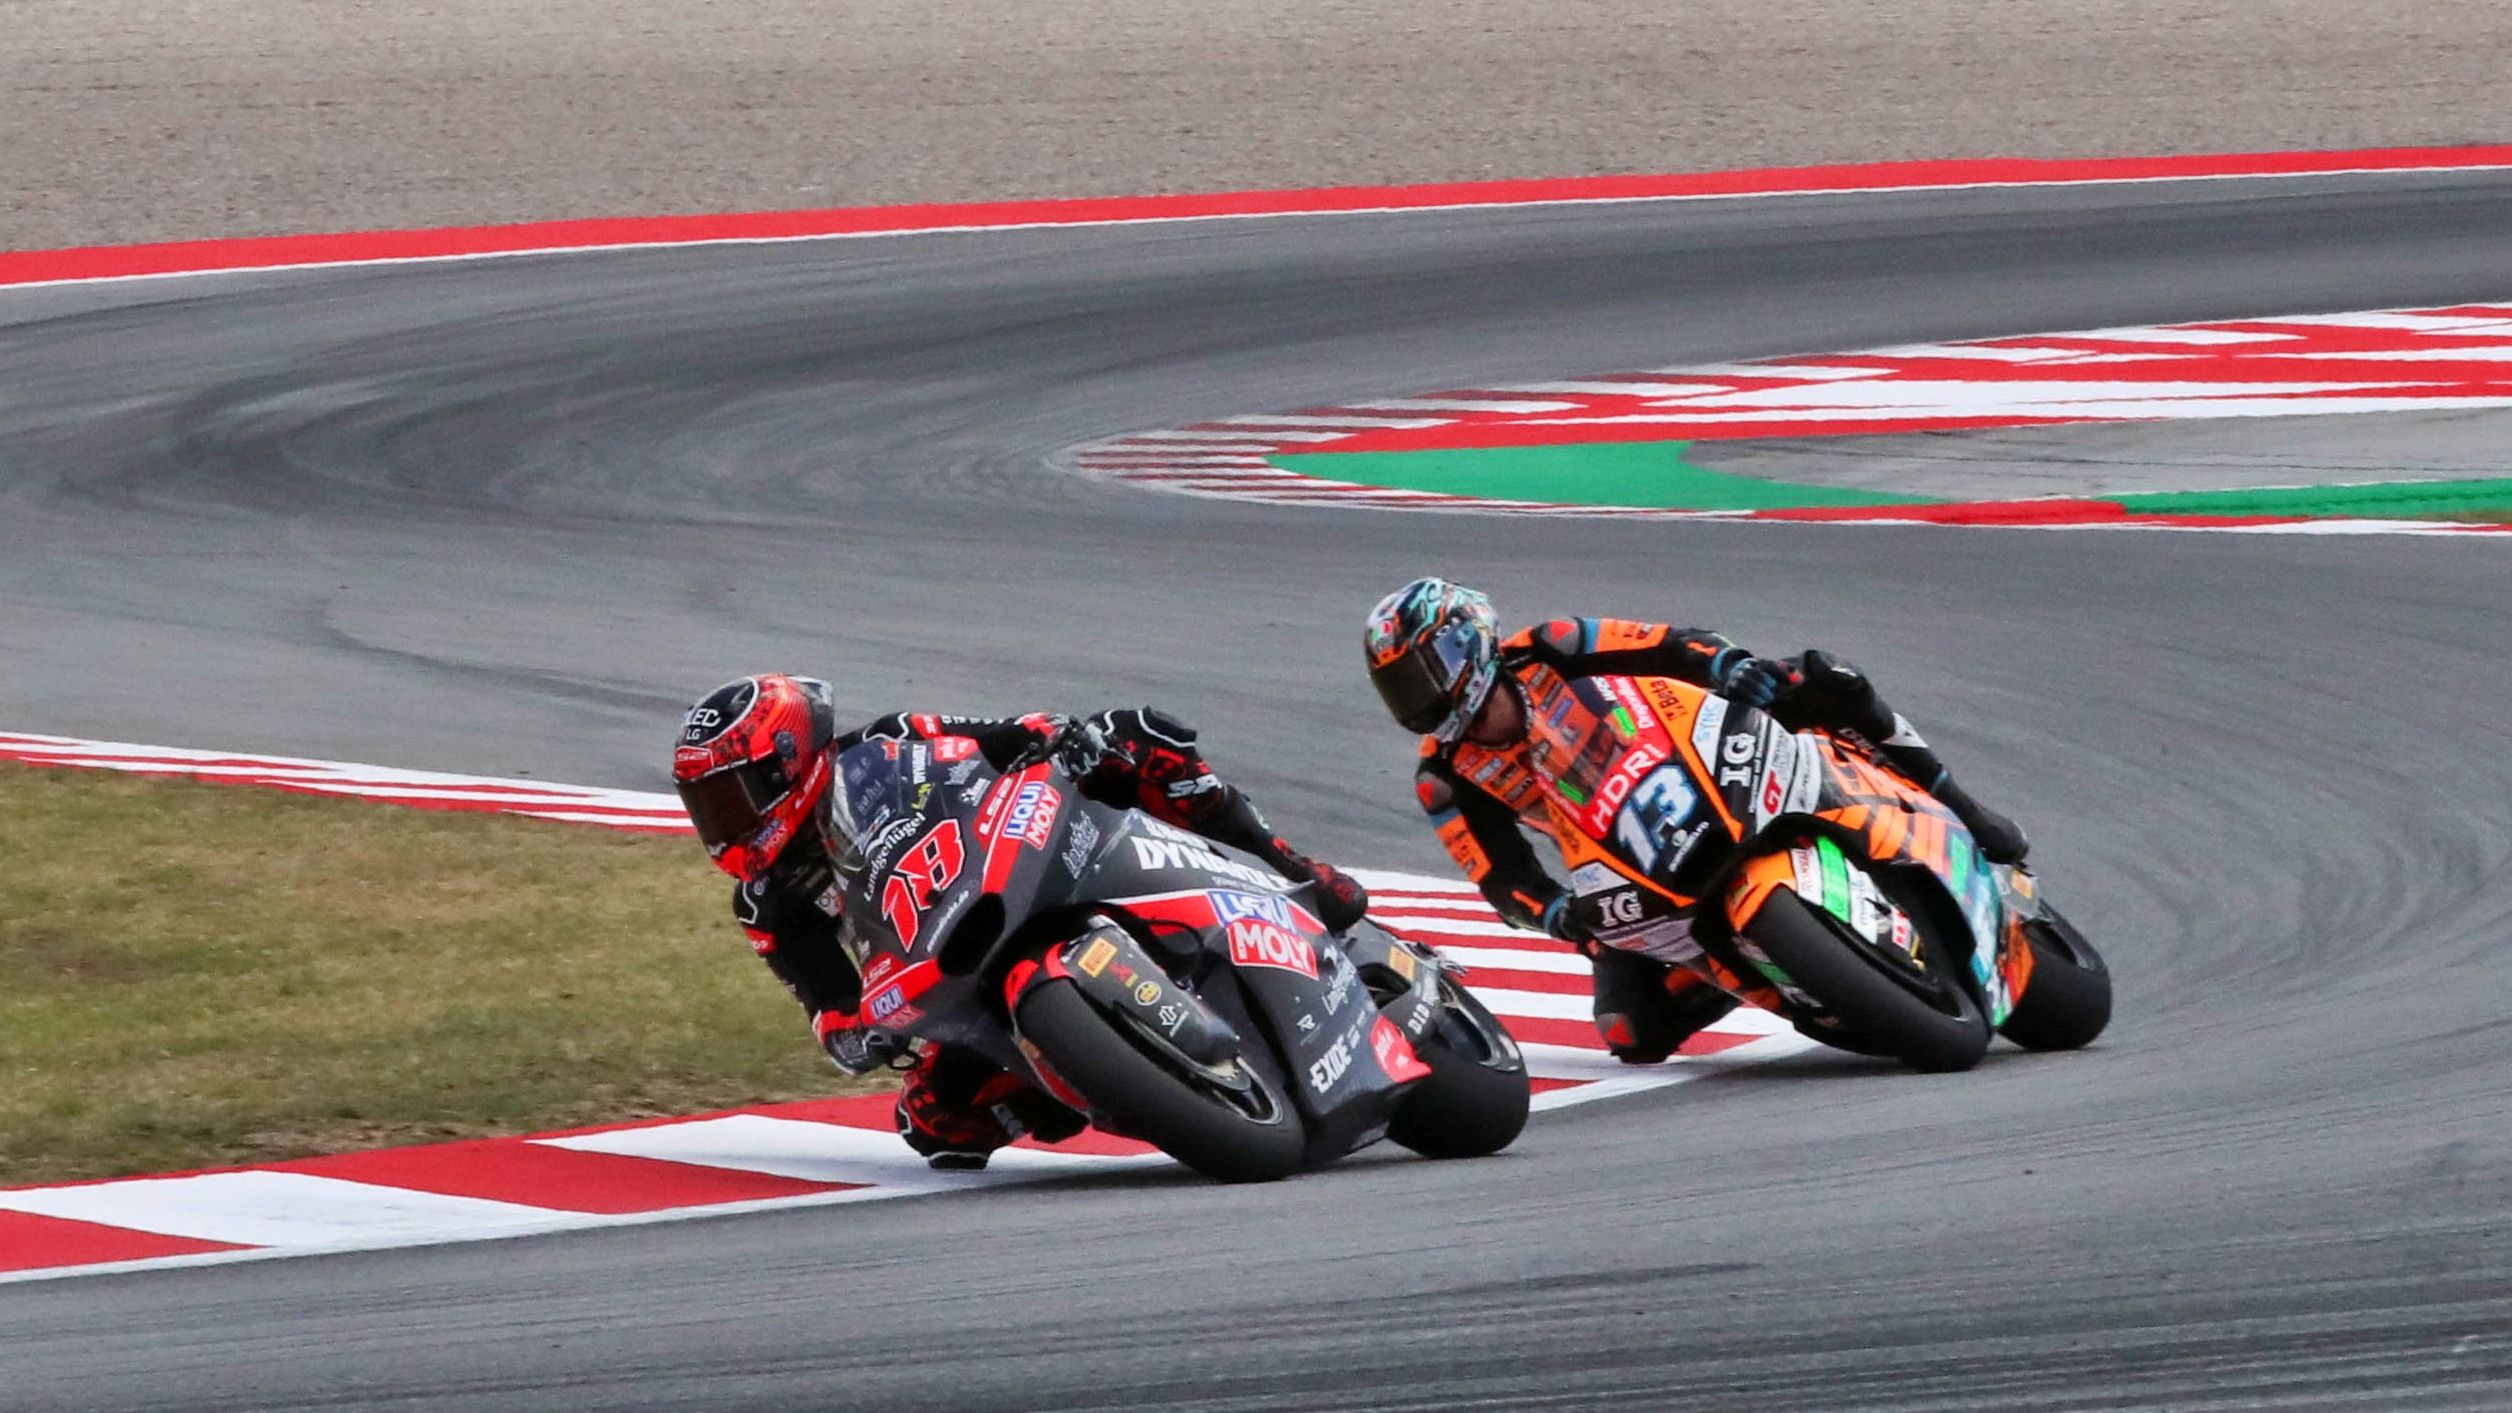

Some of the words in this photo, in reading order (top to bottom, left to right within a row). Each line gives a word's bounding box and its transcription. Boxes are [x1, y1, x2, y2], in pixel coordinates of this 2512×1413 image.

[1650, 679, 1680, 709] Beta
[1697, 703, 1718, 742] SYNC
[1720, 733, 1756, 787] IG
[1004, 782, 1045, 836] LIQUI
[1026, 787, 1060, 846] MOLY
[1617, 764, 1698, 876] 13
[881, 818, 966, 954] 18
[1597, 890, 1643, 928] IG
[1212, 893, 1299, 934] LIQUI
[1233, 921, 1313, 975] MOLY
[1309, 1033, 1353, 1094] EXIDE
